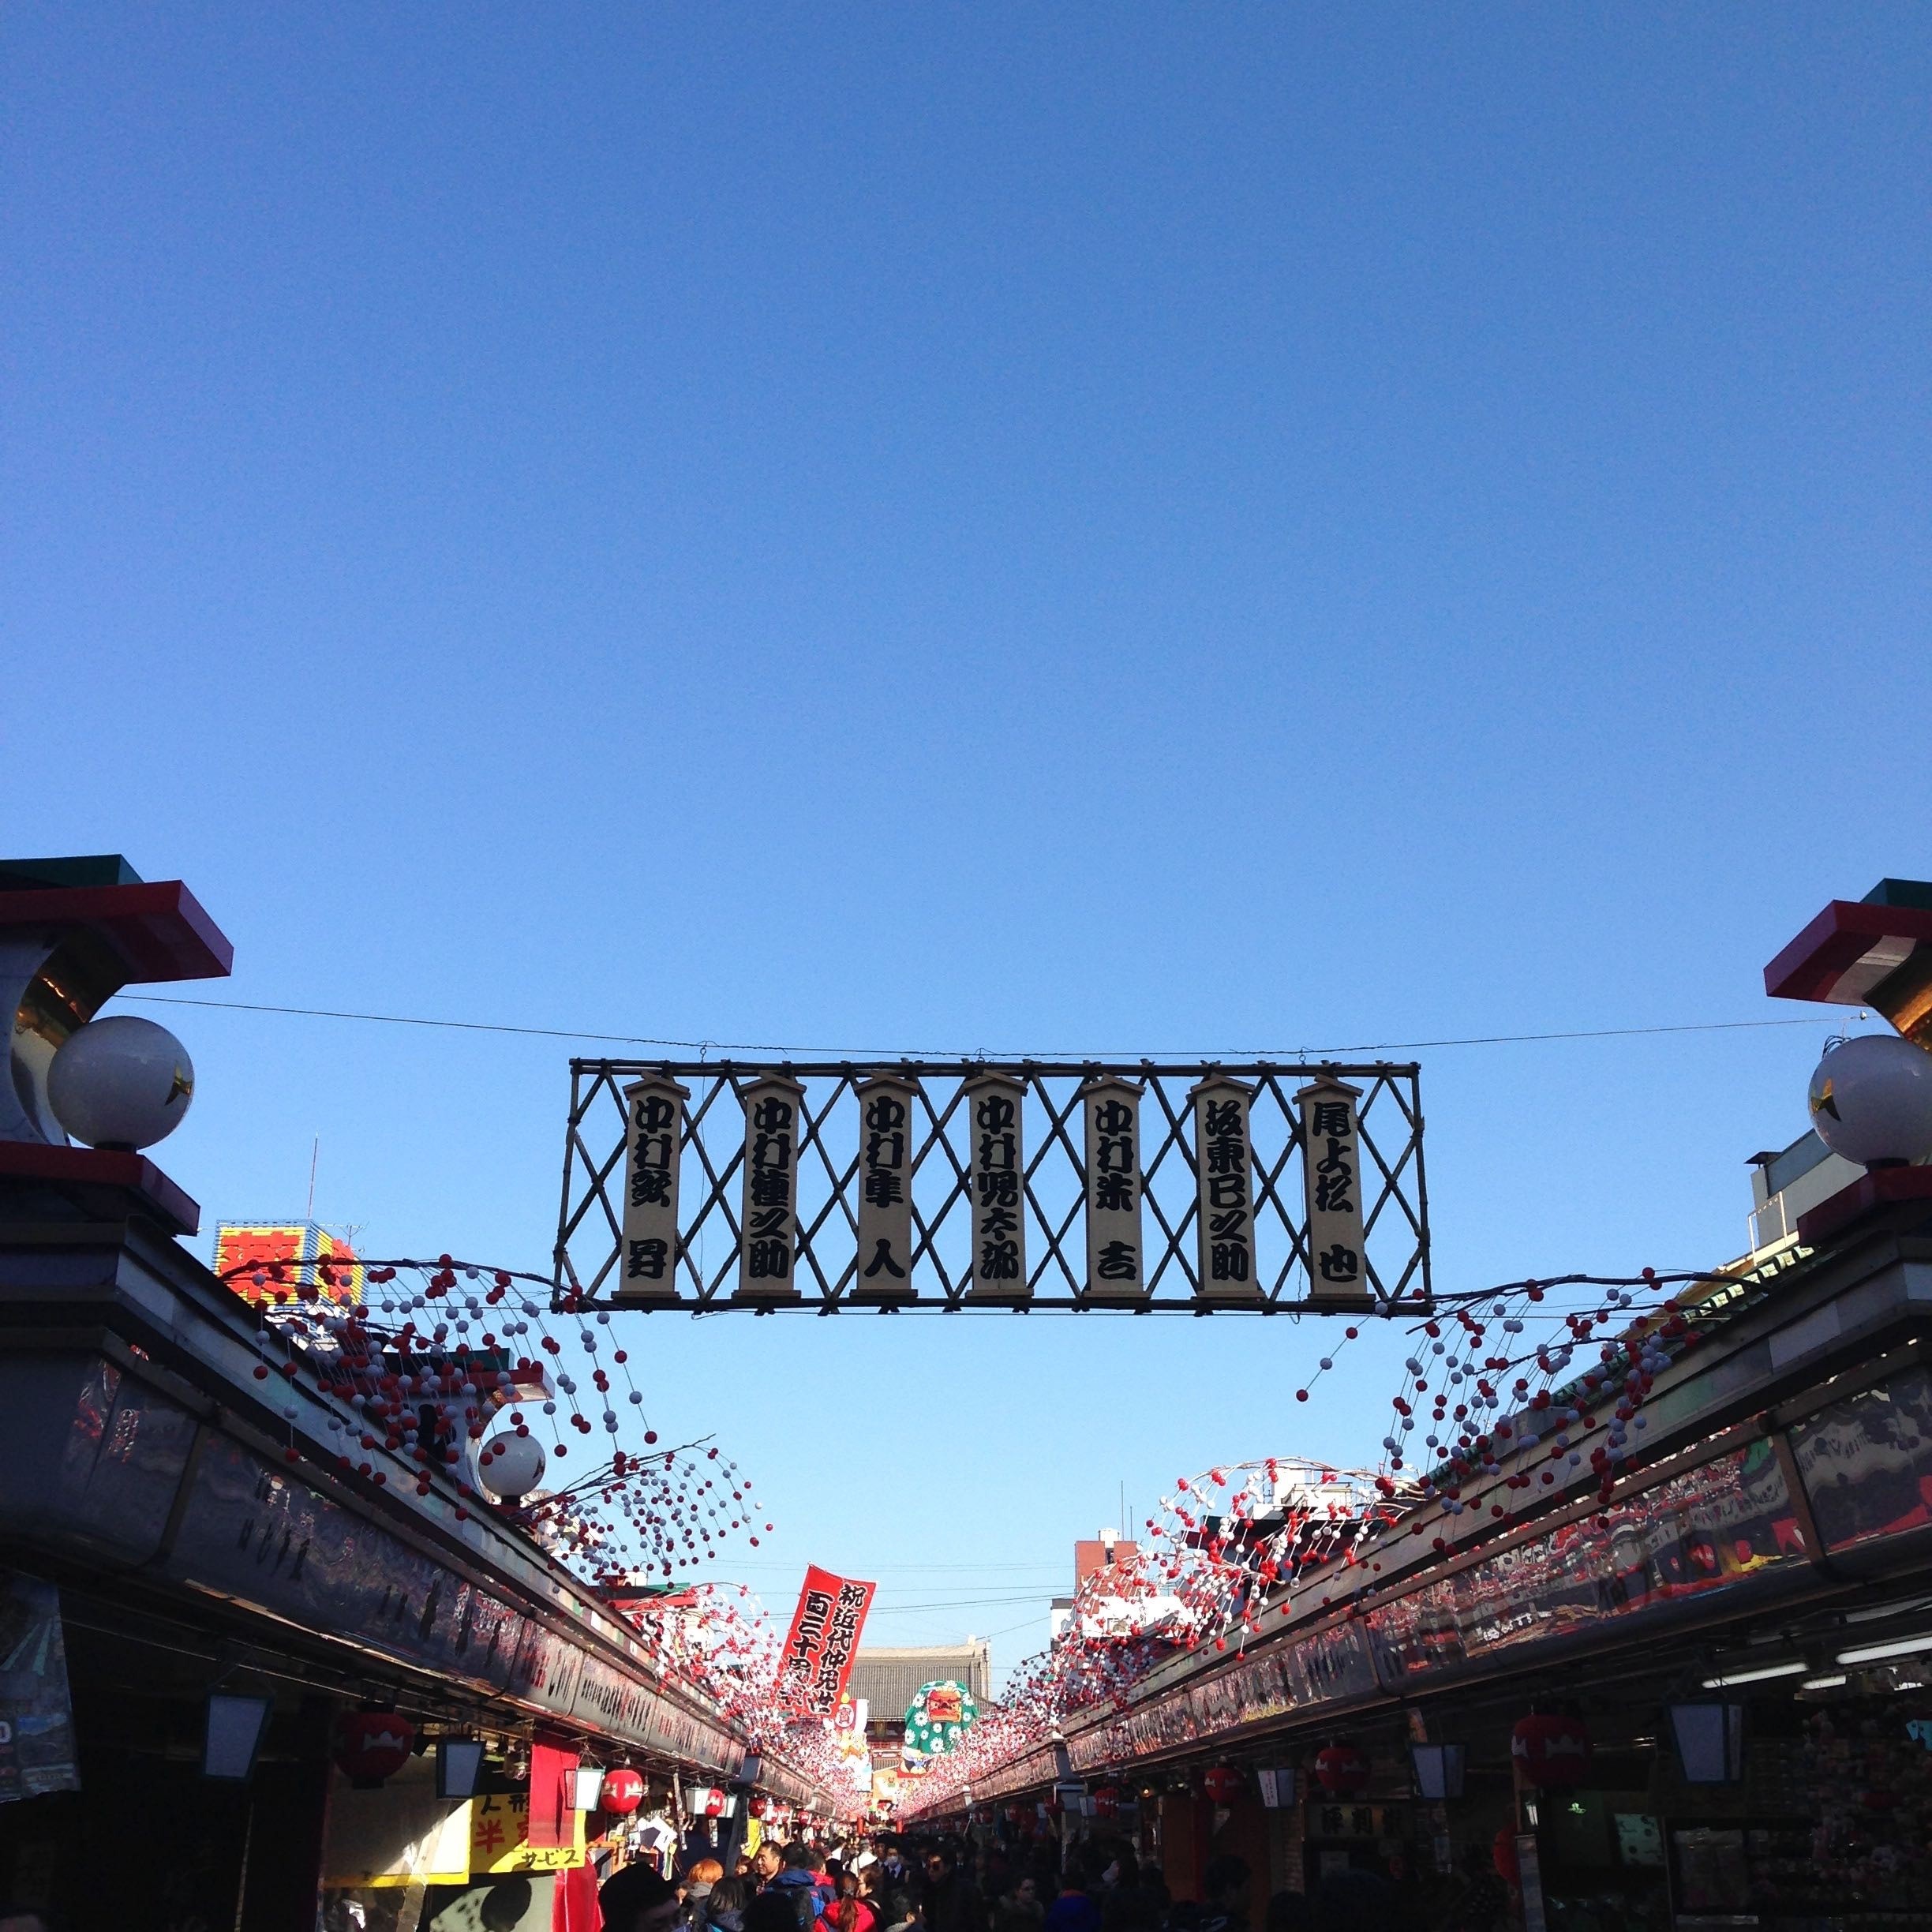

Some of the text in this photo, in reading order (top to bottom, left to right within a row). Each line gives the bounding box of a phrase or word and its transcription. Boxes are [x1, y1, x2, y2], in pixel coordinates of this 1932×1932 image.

[748, 1096, 792, 1279] 中村種之助
[863, 1095, 906, 1279] 中村隼人
[976, 1095, 1020, 1280] 中村児太郎
[1095, 1099, 1137, 1280] 中村米吉
[1204, 1099, 1249, 1282] 坂東巳之助
[1312, 1101, 1358, 1283] 尾上松也
[808, 1583, 867, 1714] 祝近代仲見世
[521, 1848, 581, 1868] サービス
